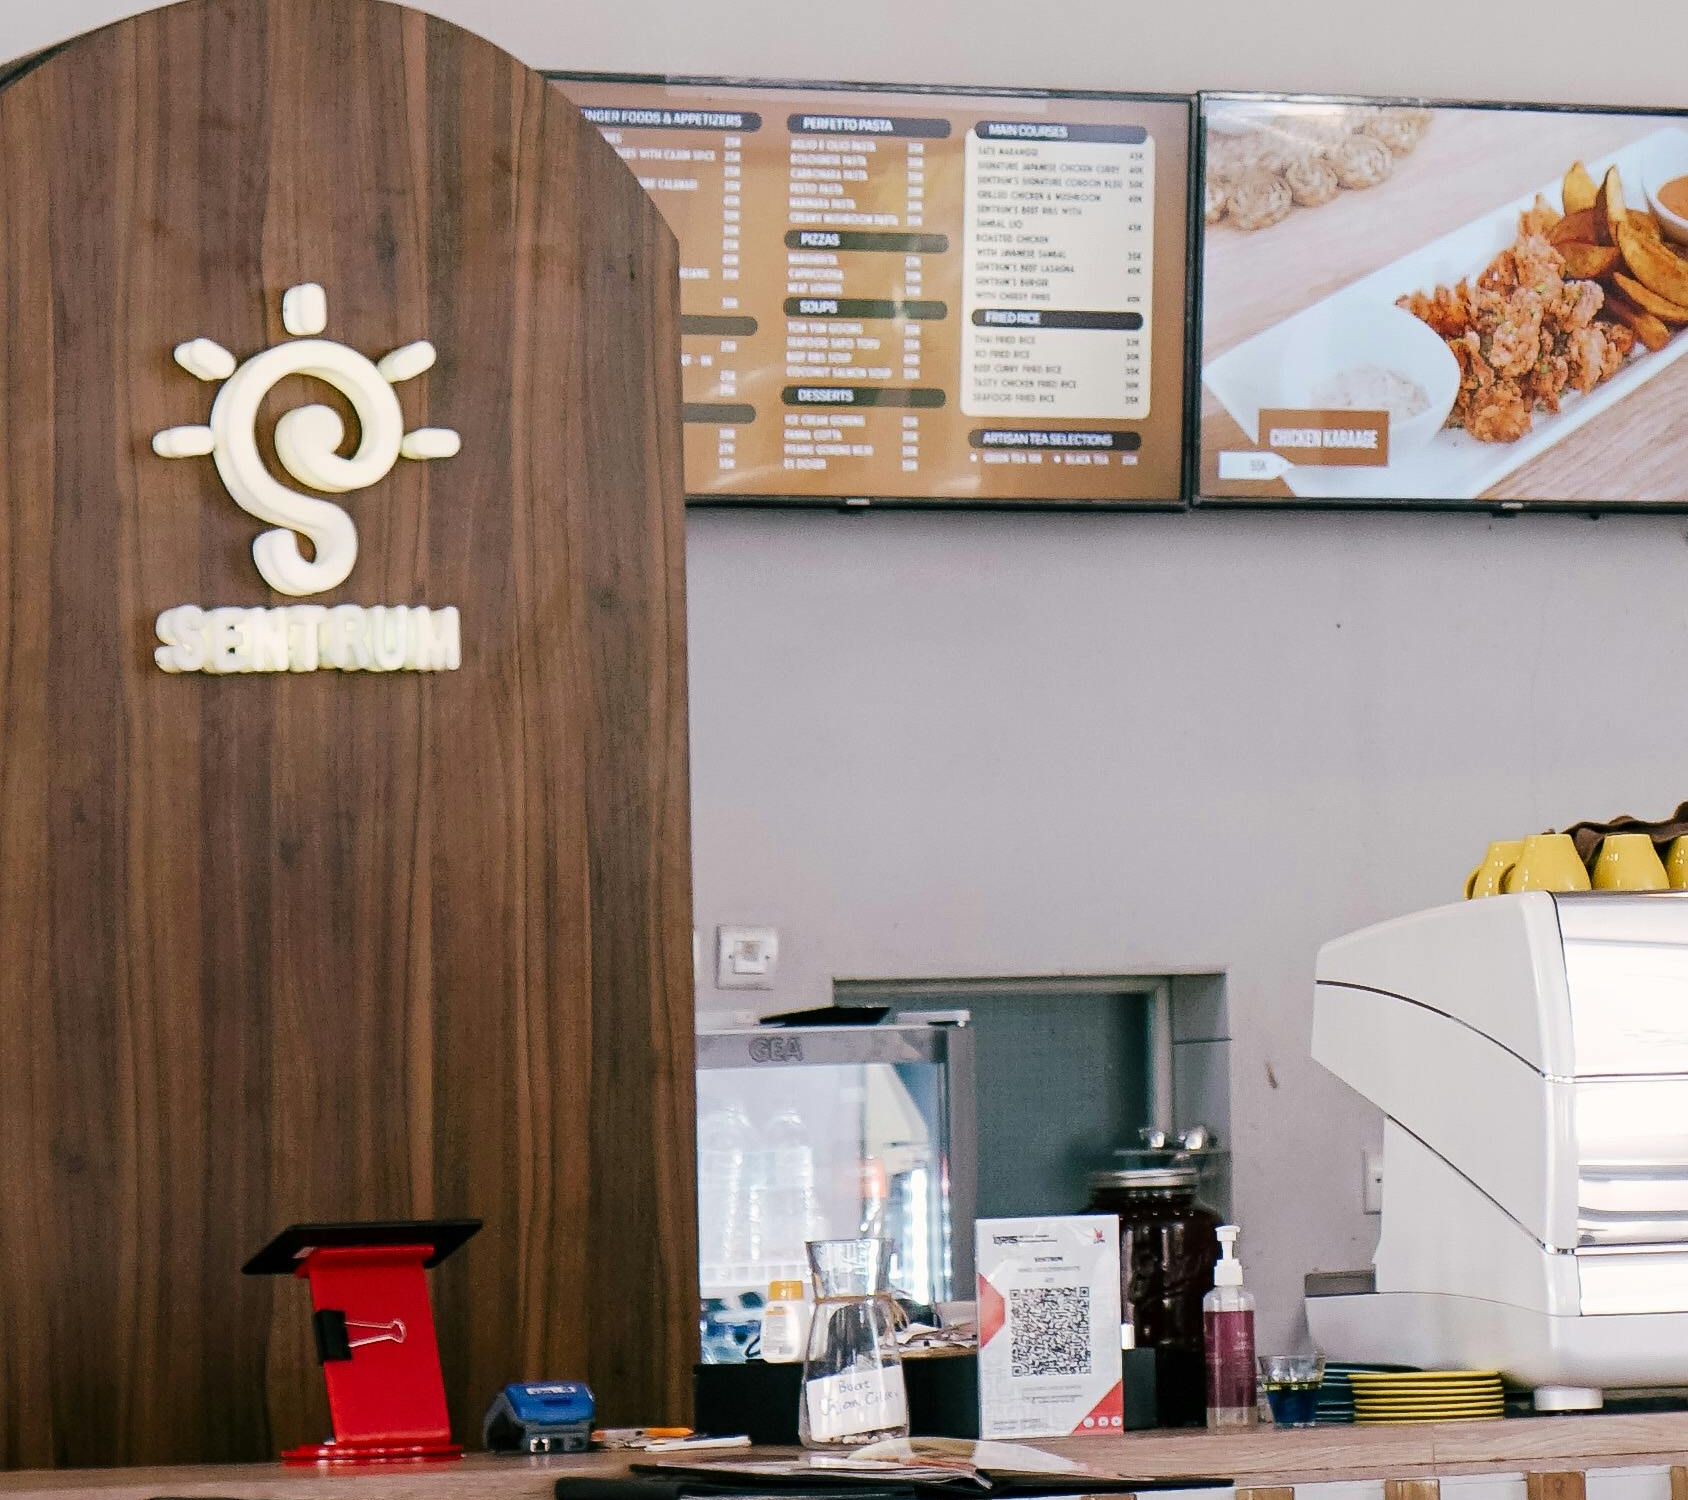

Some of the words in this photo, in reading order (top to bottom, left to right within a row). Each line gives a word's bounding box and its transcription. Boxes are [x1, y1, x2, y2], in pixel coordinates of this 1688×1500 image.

[674, 112, 742, 128] APPETIZERS
[802, 116, 858, 130] PERFETTO
[858, 119, 894, 132] PASTA
[800, 232, 840, 246] PIZZAS
[800, 300, 838, 314] SOUPS
[797, 388, 854, 402] DESSERTS
[1050, 433, 1113, 446] SELECTIONS
[155, 605, 460, 673] SENTRUM
